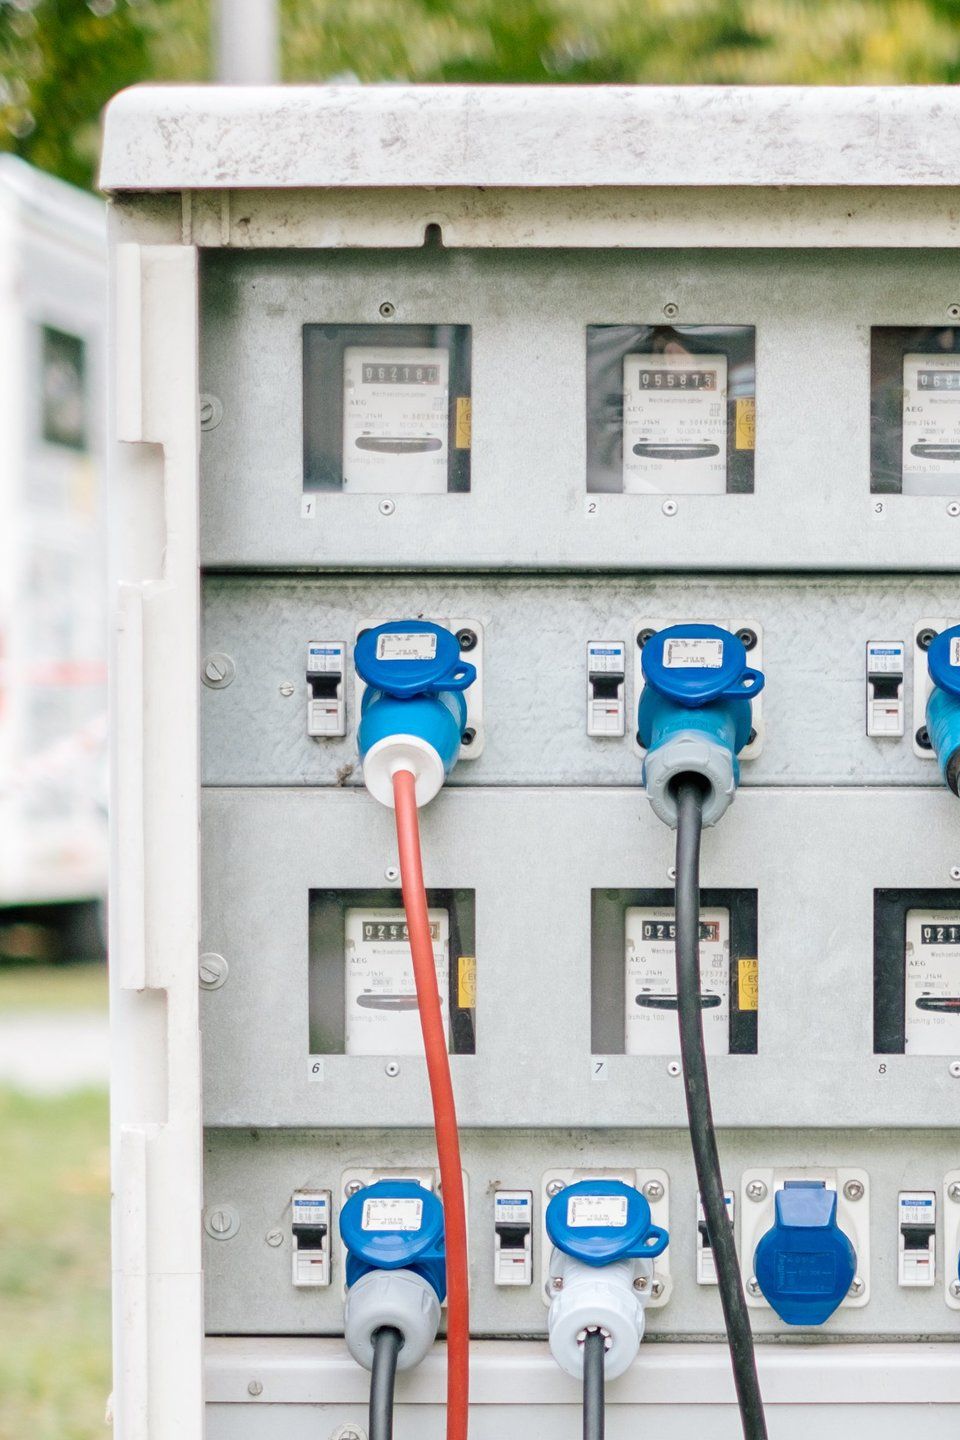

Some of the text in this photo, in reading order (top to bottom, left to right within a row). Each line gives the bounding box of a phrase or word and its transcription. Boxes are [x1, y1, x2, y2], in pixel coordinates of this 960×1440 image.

[306, 504, 311, 513] 1
[588, 503, 596, 513] 2
[875, 503, 883, 513] 3
[312, 1063, 320, 1073] 6
[594, 1063, 604, 1073] 7
[879, 1064, 887, 1074] 8
